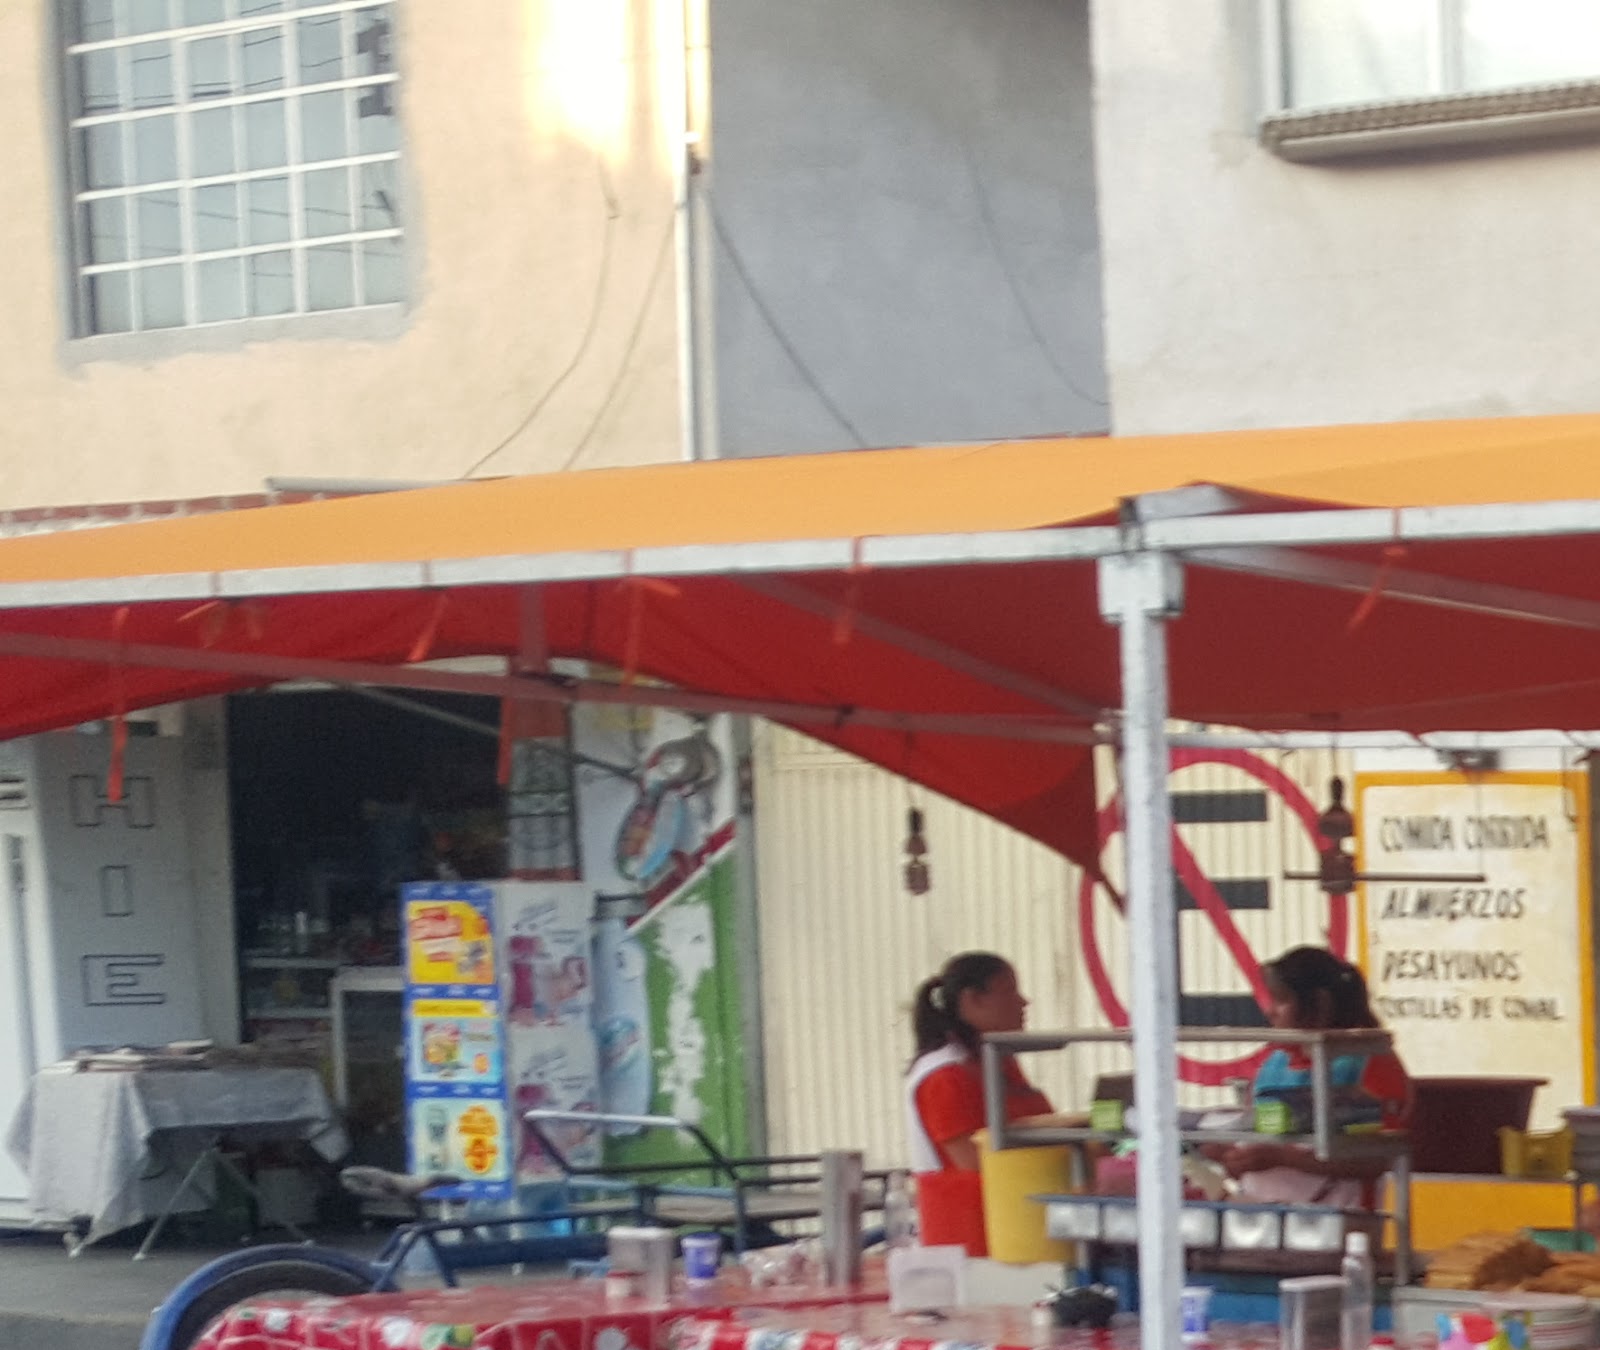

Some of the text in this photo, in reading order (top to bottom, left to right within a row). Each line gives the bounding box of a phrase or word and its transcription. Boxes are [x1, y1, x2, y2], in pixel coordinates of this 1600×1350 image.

[1380, 815, 1550, 852] COMIDA CORRIDA
[1381, 887, 1527, 919] ALMUERZOS
[1382, 950, 1522, 982] DESAYUNOS
[1471, 997, 1494, 1020] DE
